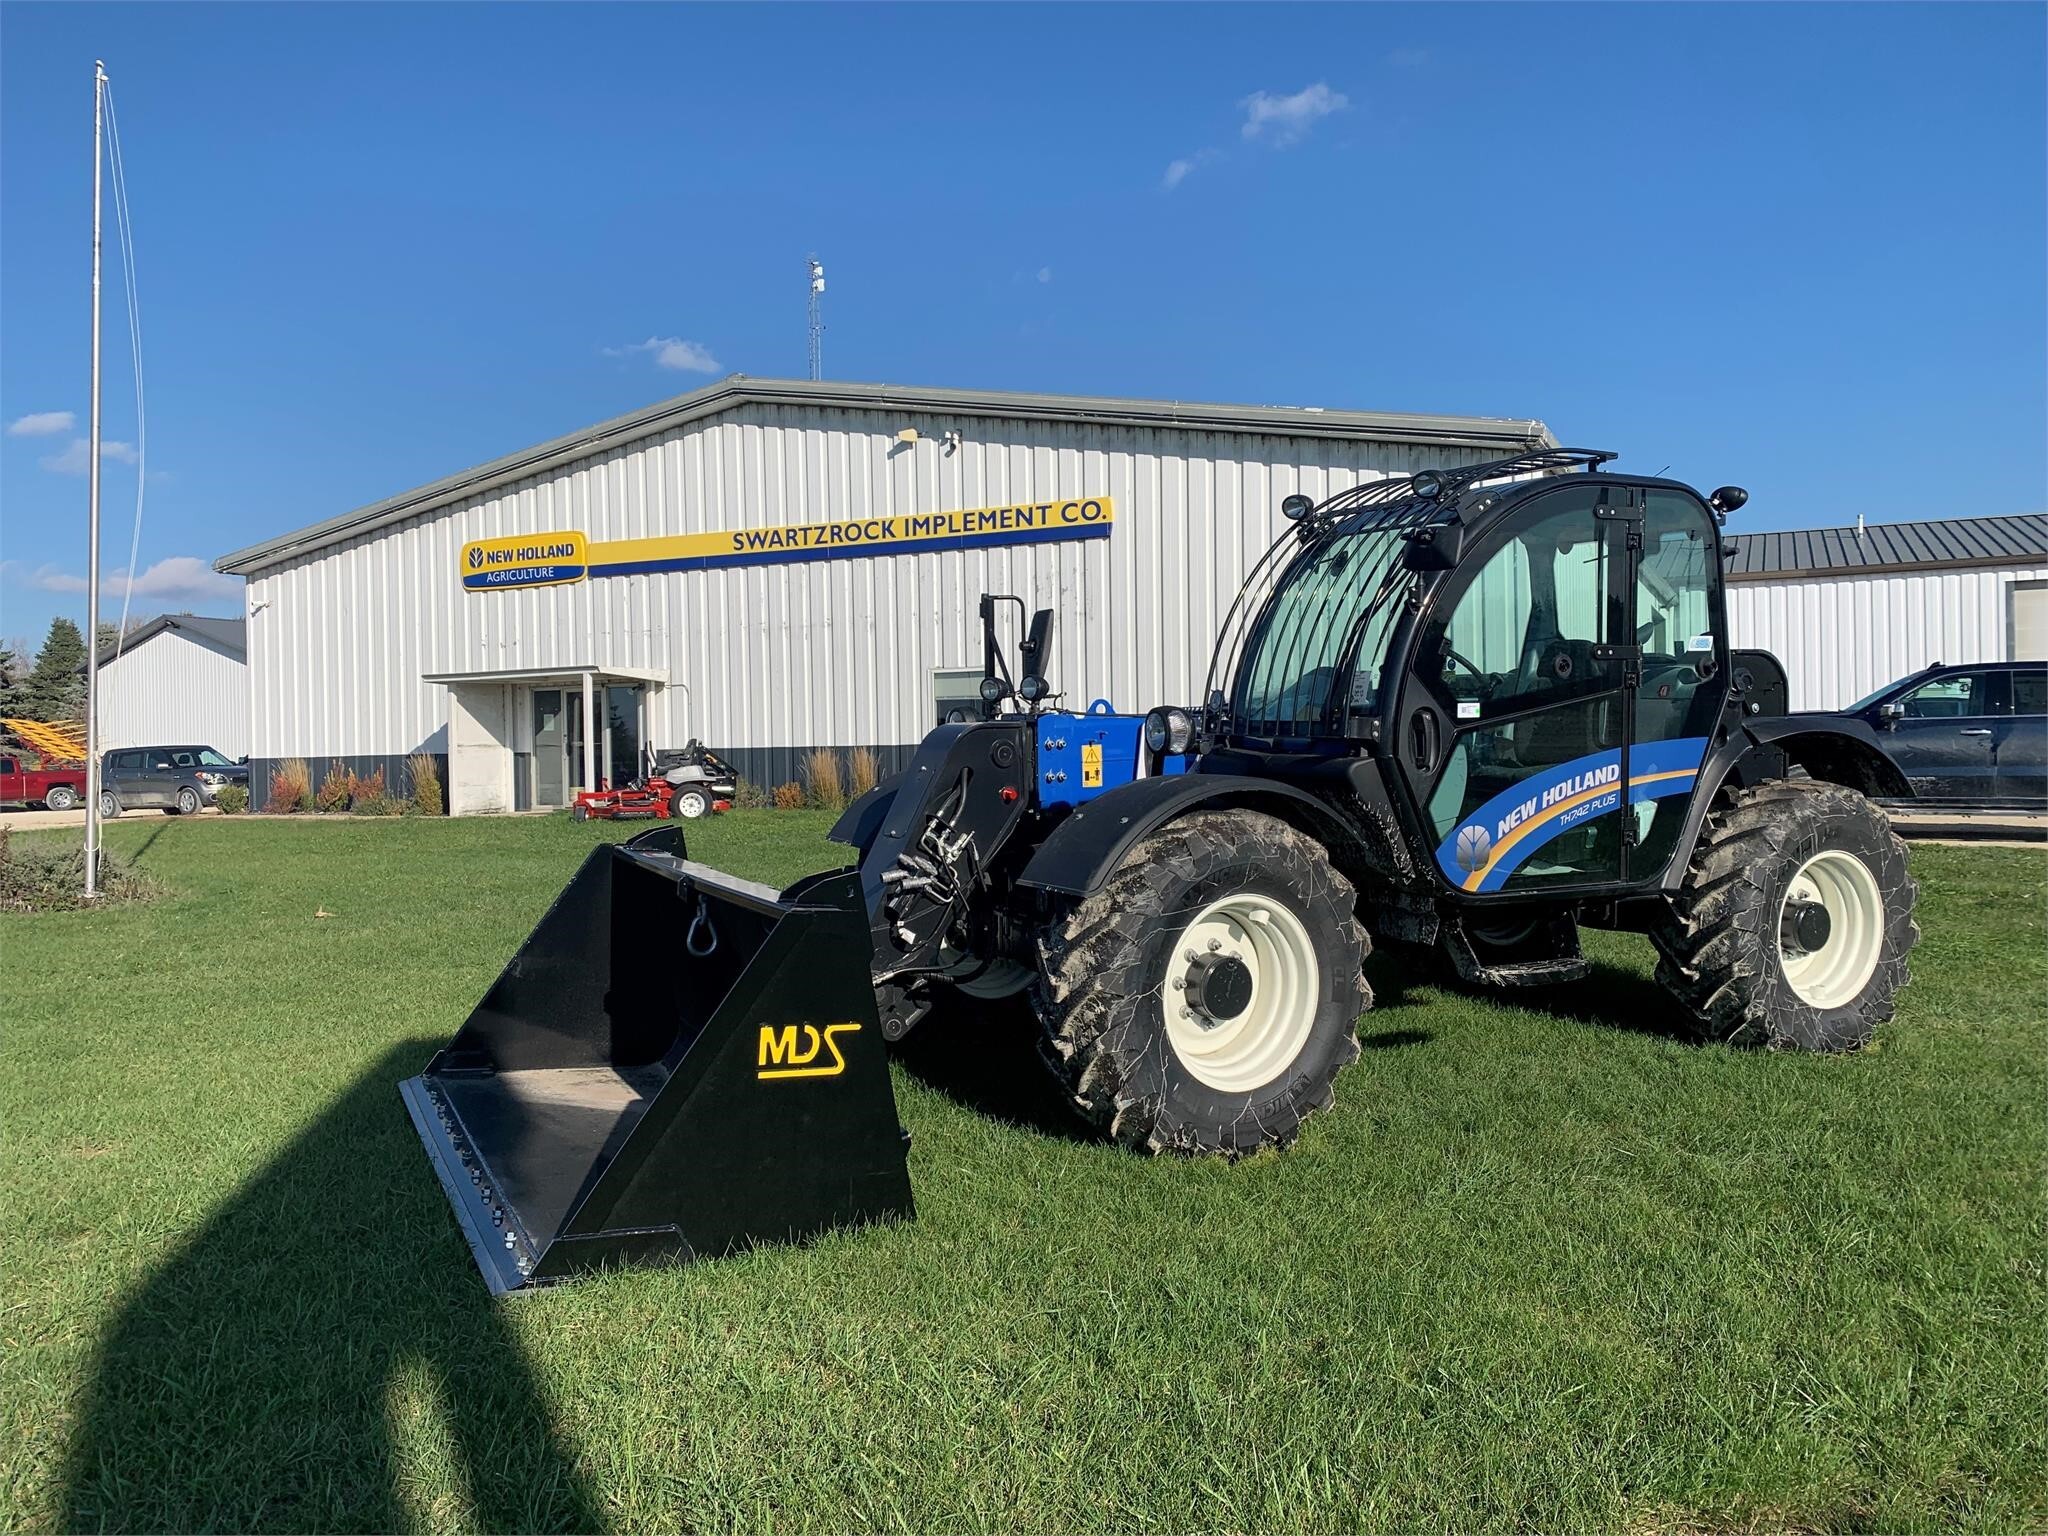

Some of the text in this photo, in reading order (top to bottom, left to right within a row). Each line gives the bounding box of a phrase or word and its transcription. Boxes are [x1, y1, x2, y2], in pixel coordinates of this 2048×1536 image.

[732, 500, 1107, 551] SWARTZROCK IMPLEMENT CO.
[486, 543, 574, 565] NEW HOLLAND
[486, 567, 555, 583] AGRICULTURE
[1498, 764, 1619, 840] NEW HOLLAND
[1591, 793, 1617, 811] PLUS
[758, 1023, 862, 1080] MDS
